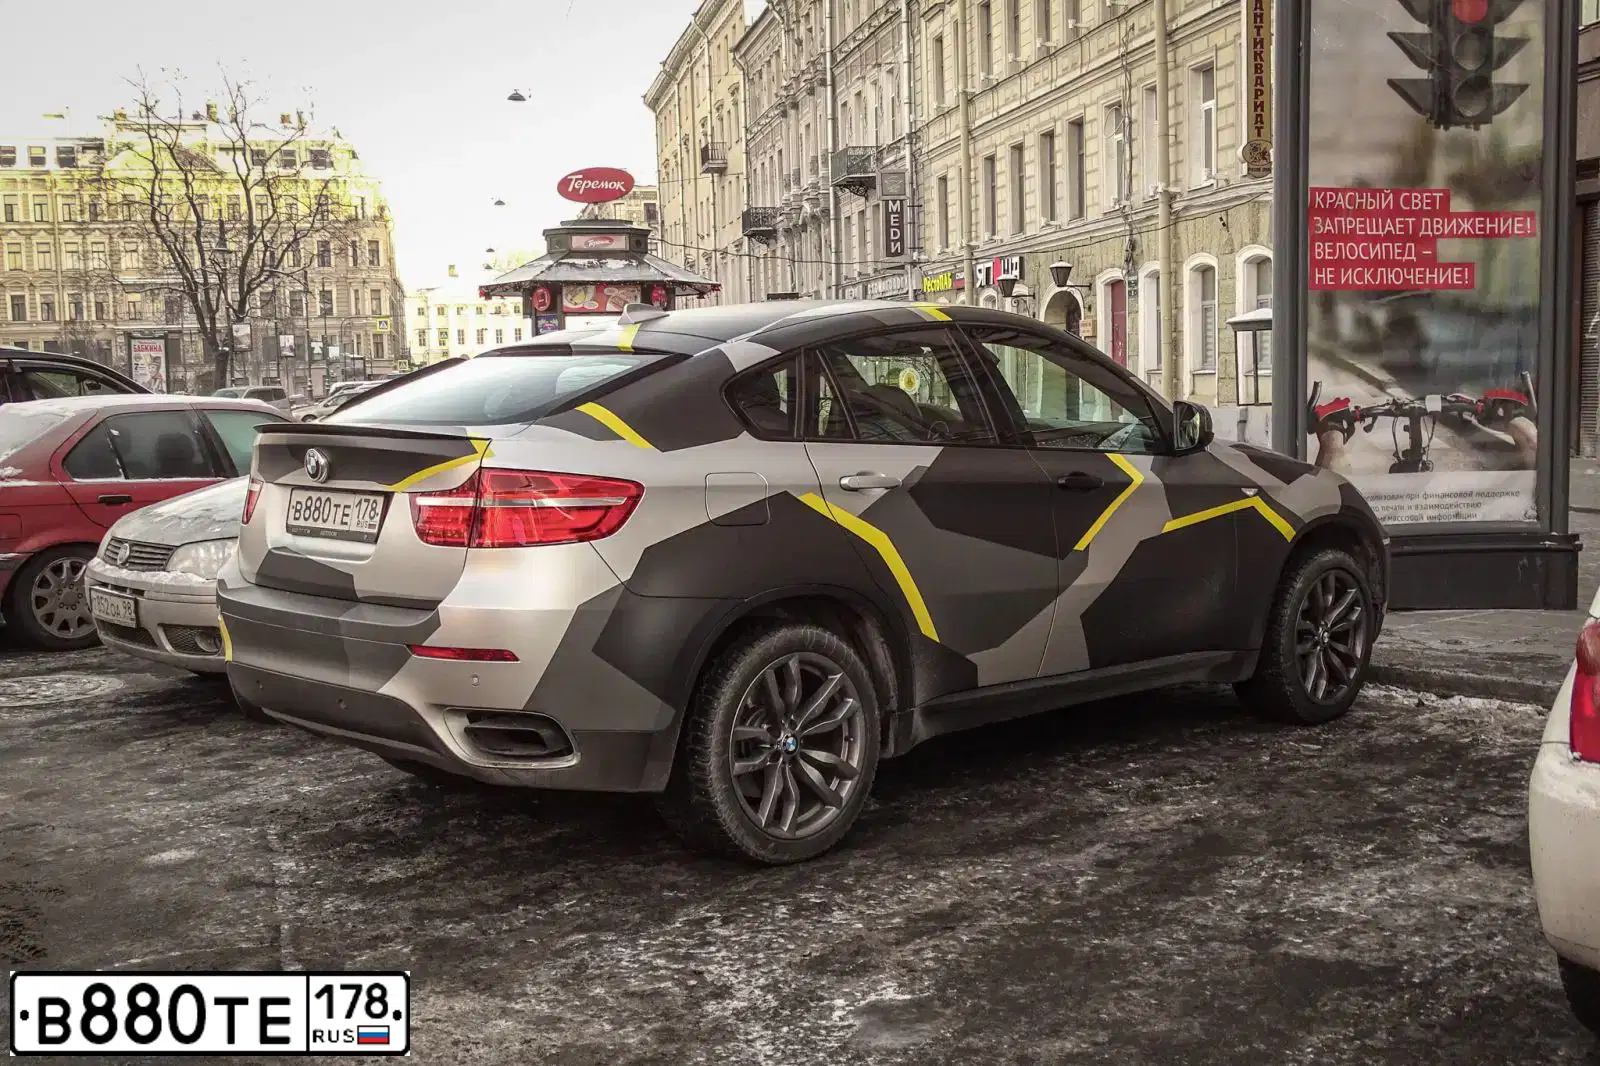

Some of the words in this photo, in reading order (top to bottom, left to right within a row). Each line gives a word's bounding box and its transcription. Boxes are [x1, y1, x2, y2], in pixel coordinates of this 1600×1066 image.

[1253, 0, 1265, 137] АНТИКВАРИАТ
[567, 175, 626, 194] Теремок
[1314, 190, 1394, 210] КРАСНЫЙ
[1399, 191, 1444, 210] СВЕТ
[1313, 216, 1416, 236] ЗАПРЕЩАЕТ
[1419, 216, 1532, 237] ДВИЖЕНИЕ!
[1314, 242, 1417, 262] ВЕЛОСИПЕД
[1314, 268, 1335, 285] НЕ
[1340, 267, 1469, 286] ИСКЛЮЧЕНИЕ!
[133, 344, 163, 352] БАБКИНА
[1422, 491, 1473, 500] финансовой
[1475, 490, 1520, 498] поддержке
[293, 496, 351, 526] В880ТЕ
[355, 498, 378, 520] 178
